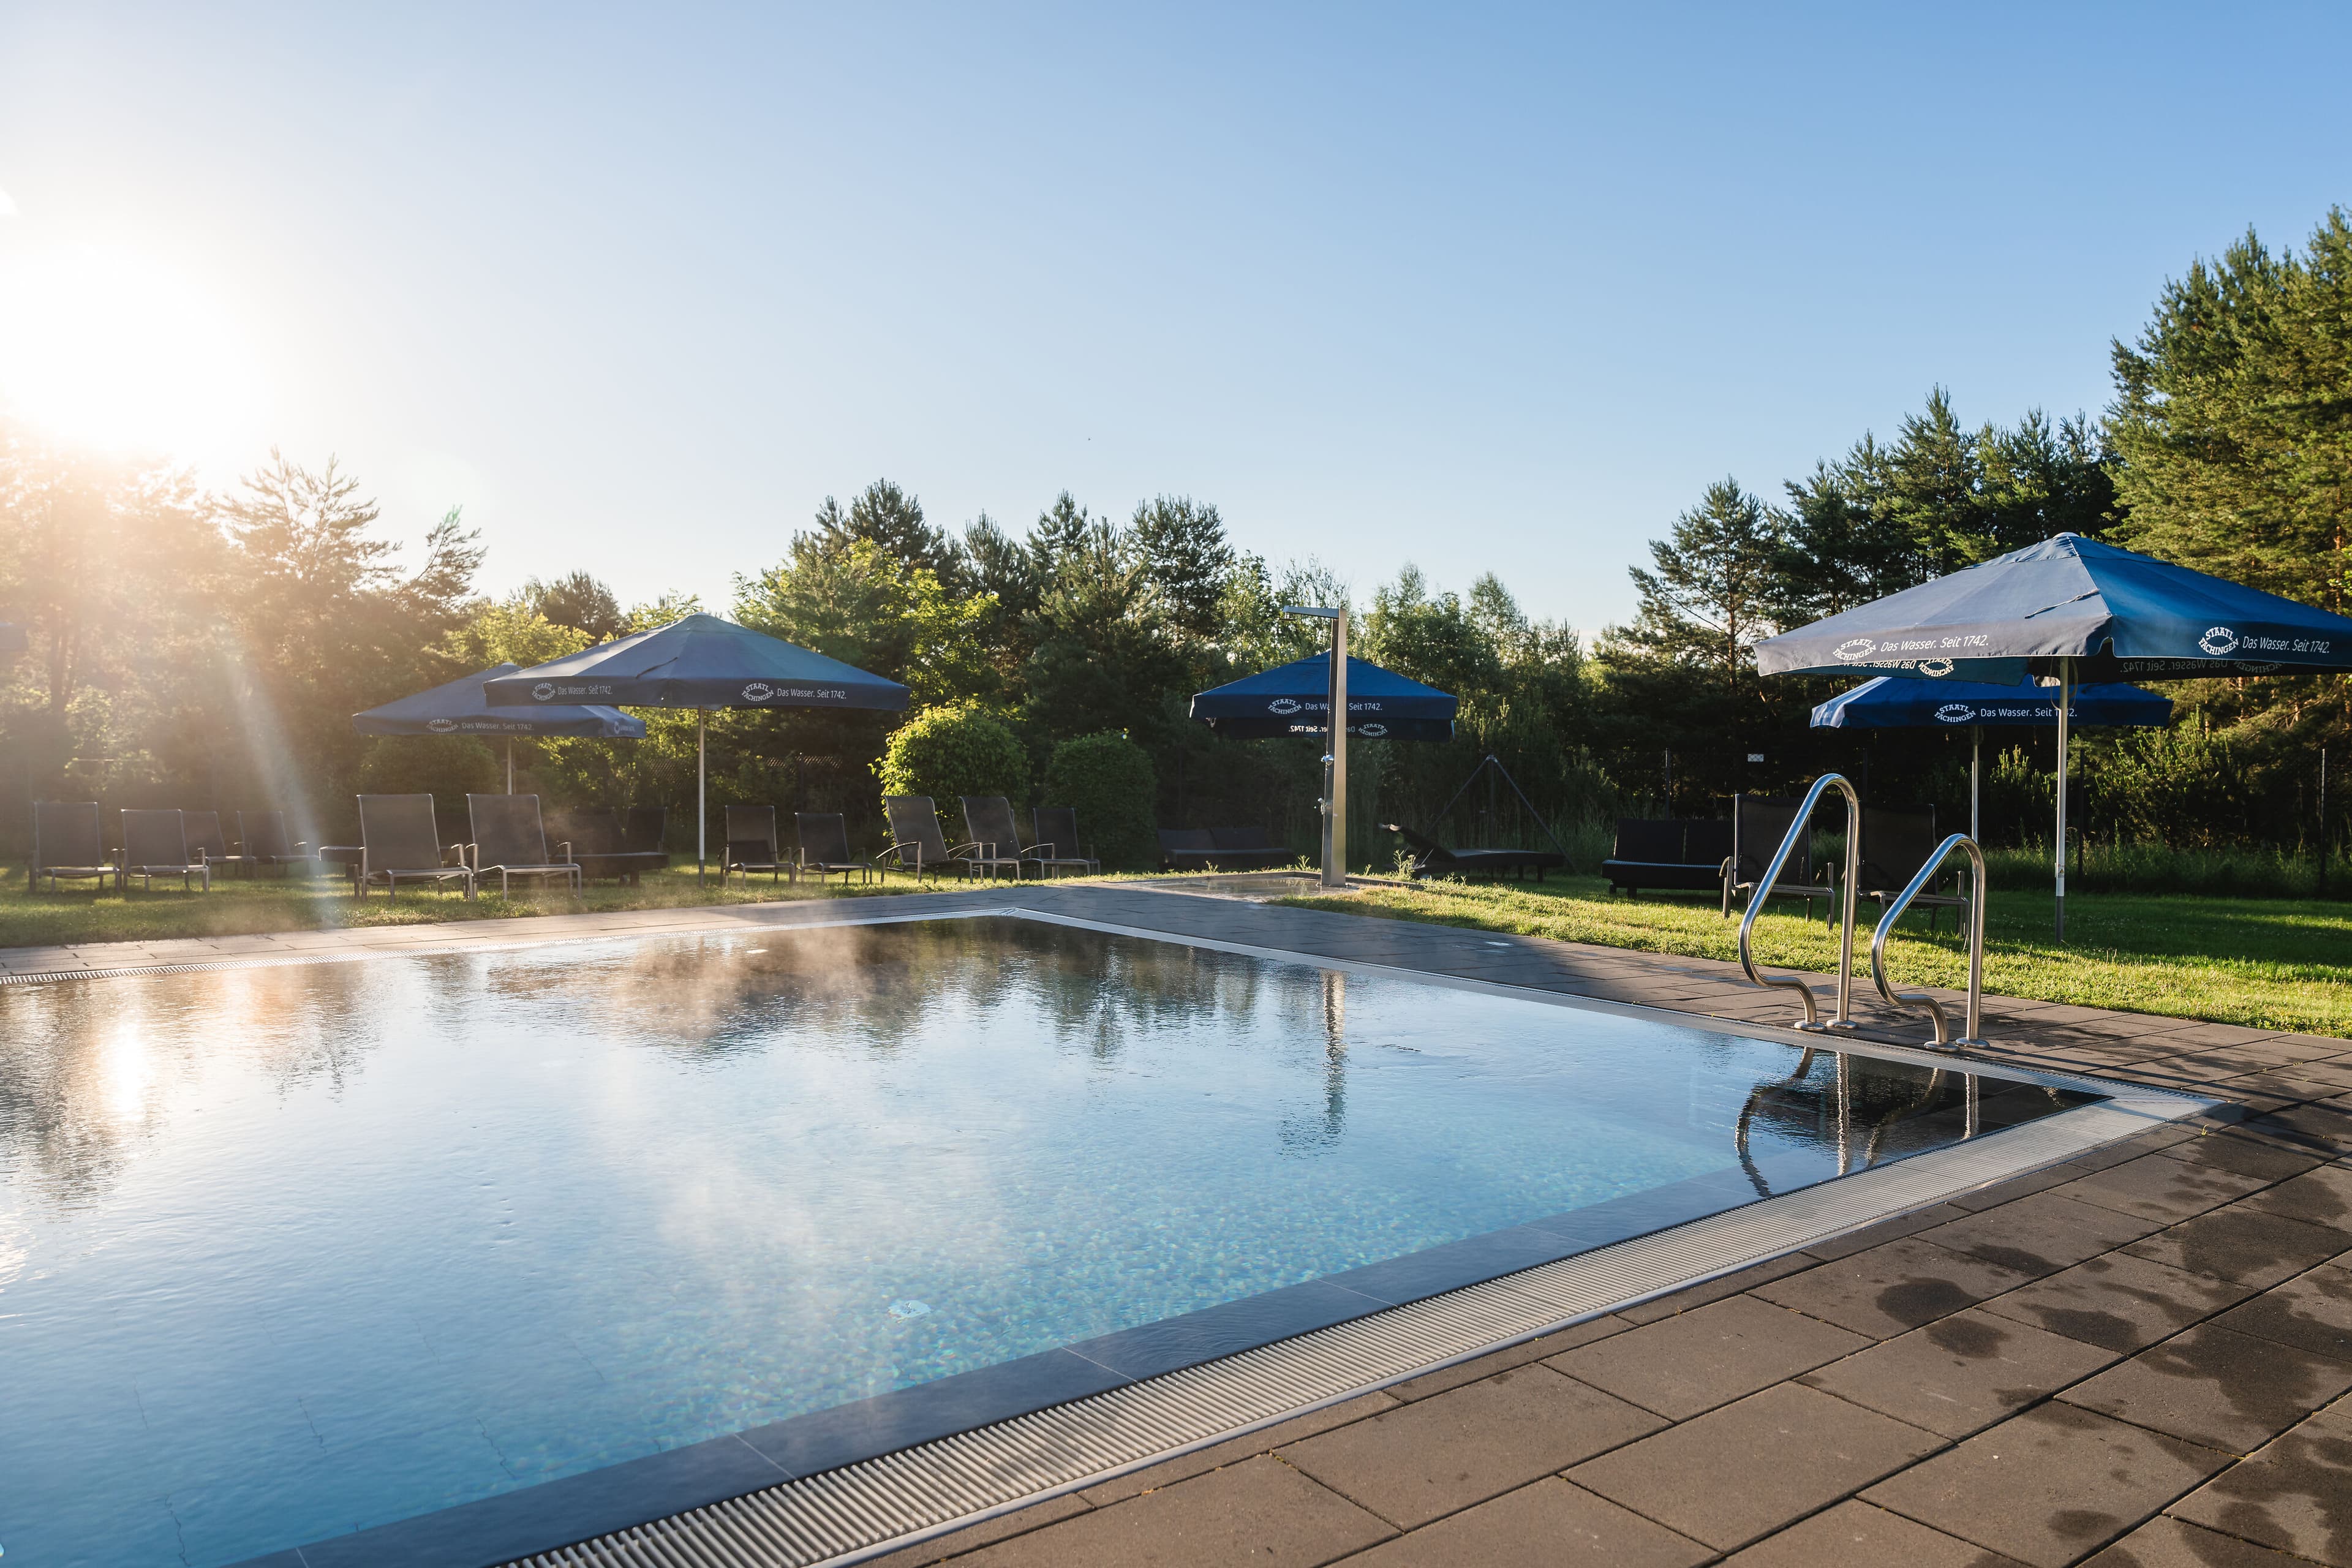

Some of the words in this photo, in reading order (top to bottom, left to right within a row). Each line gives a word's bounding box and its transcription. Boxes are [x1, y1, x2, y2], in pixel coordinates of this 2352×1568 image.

[1880, 642, 1899, 652] Das
[1901, 639, 1937, 651] Wasser.
[1940, 636, 1962, 648] Seit
[1963, 635, 1989, 647] 1742.
[2198, 637, 2239, 655] FACHINGEN
[2242, 636, 2257, 649] Das
[2260, 637, 2290, 650] Wasser.
[2292, 639, 2309, 652] Seit
[2310, 641, 2330, 654] 1742.
[1833, 644, 1876, 660] FACHINGEN
[557, 687, 567, 695] Das
[589, 685, 598, 695] Seit
[600, 686, 612, 695] 1742.
[742, 690, 774, 701] FACHINGEN
[777, 688, 789, 697] Das
[791, 689, 815, 698] Wasser.
[817, 689, 829, 698] Seit
[831, 690, 847, 699] 1742.
[1267, 704, 1302, 715] FACHINGEN
[1980, 708, 1996, 717] Das
[1998, 708, 2032, 717] Wasser.
[2035, 707, 2052, 717] Seit
[2054, 708, 2078, 717] 12.
[1934, 710, 1976, 722] FACHINGEN
